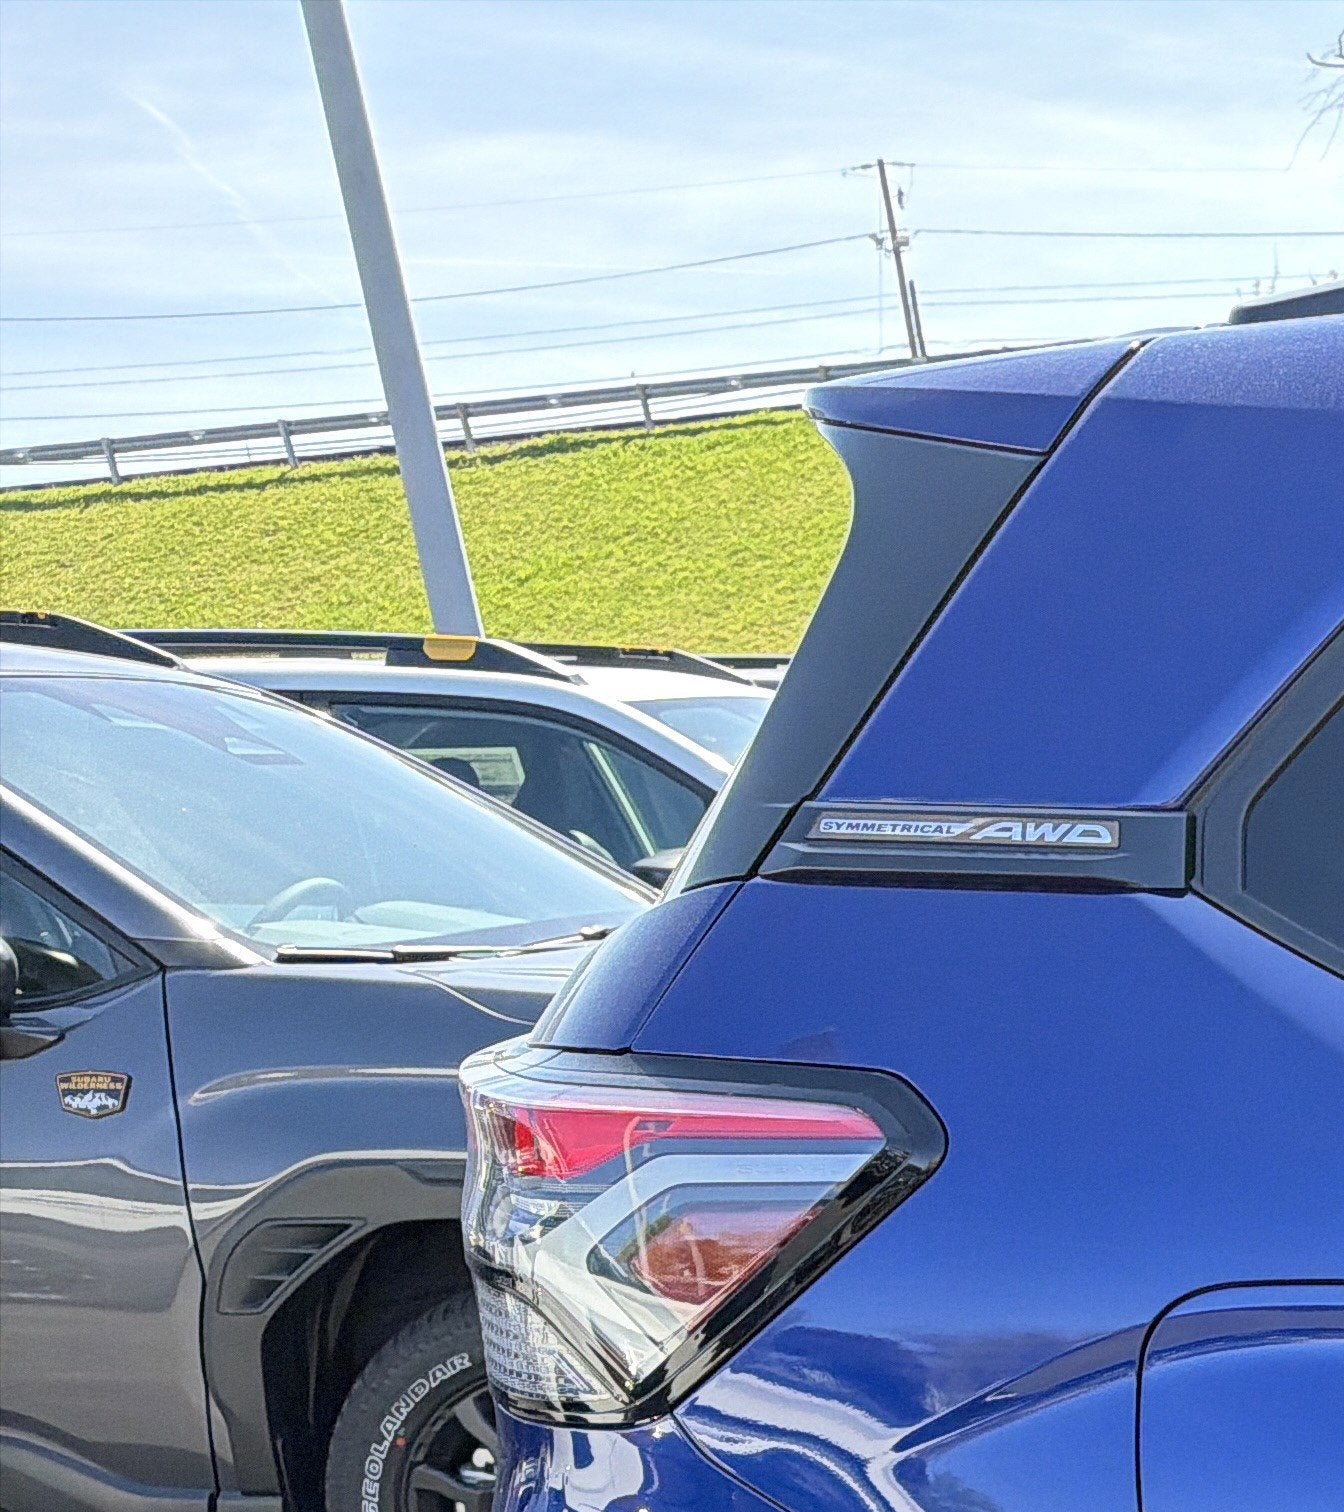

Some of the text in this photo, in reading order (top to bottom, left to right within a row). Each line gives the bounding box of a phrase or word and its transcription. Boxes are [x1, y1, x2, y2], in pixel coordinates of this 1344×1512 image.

[821, 820, 1112, 845] SYMMETRICAL AWD
[60, 1082, 124, 1090] WILDERNESS
